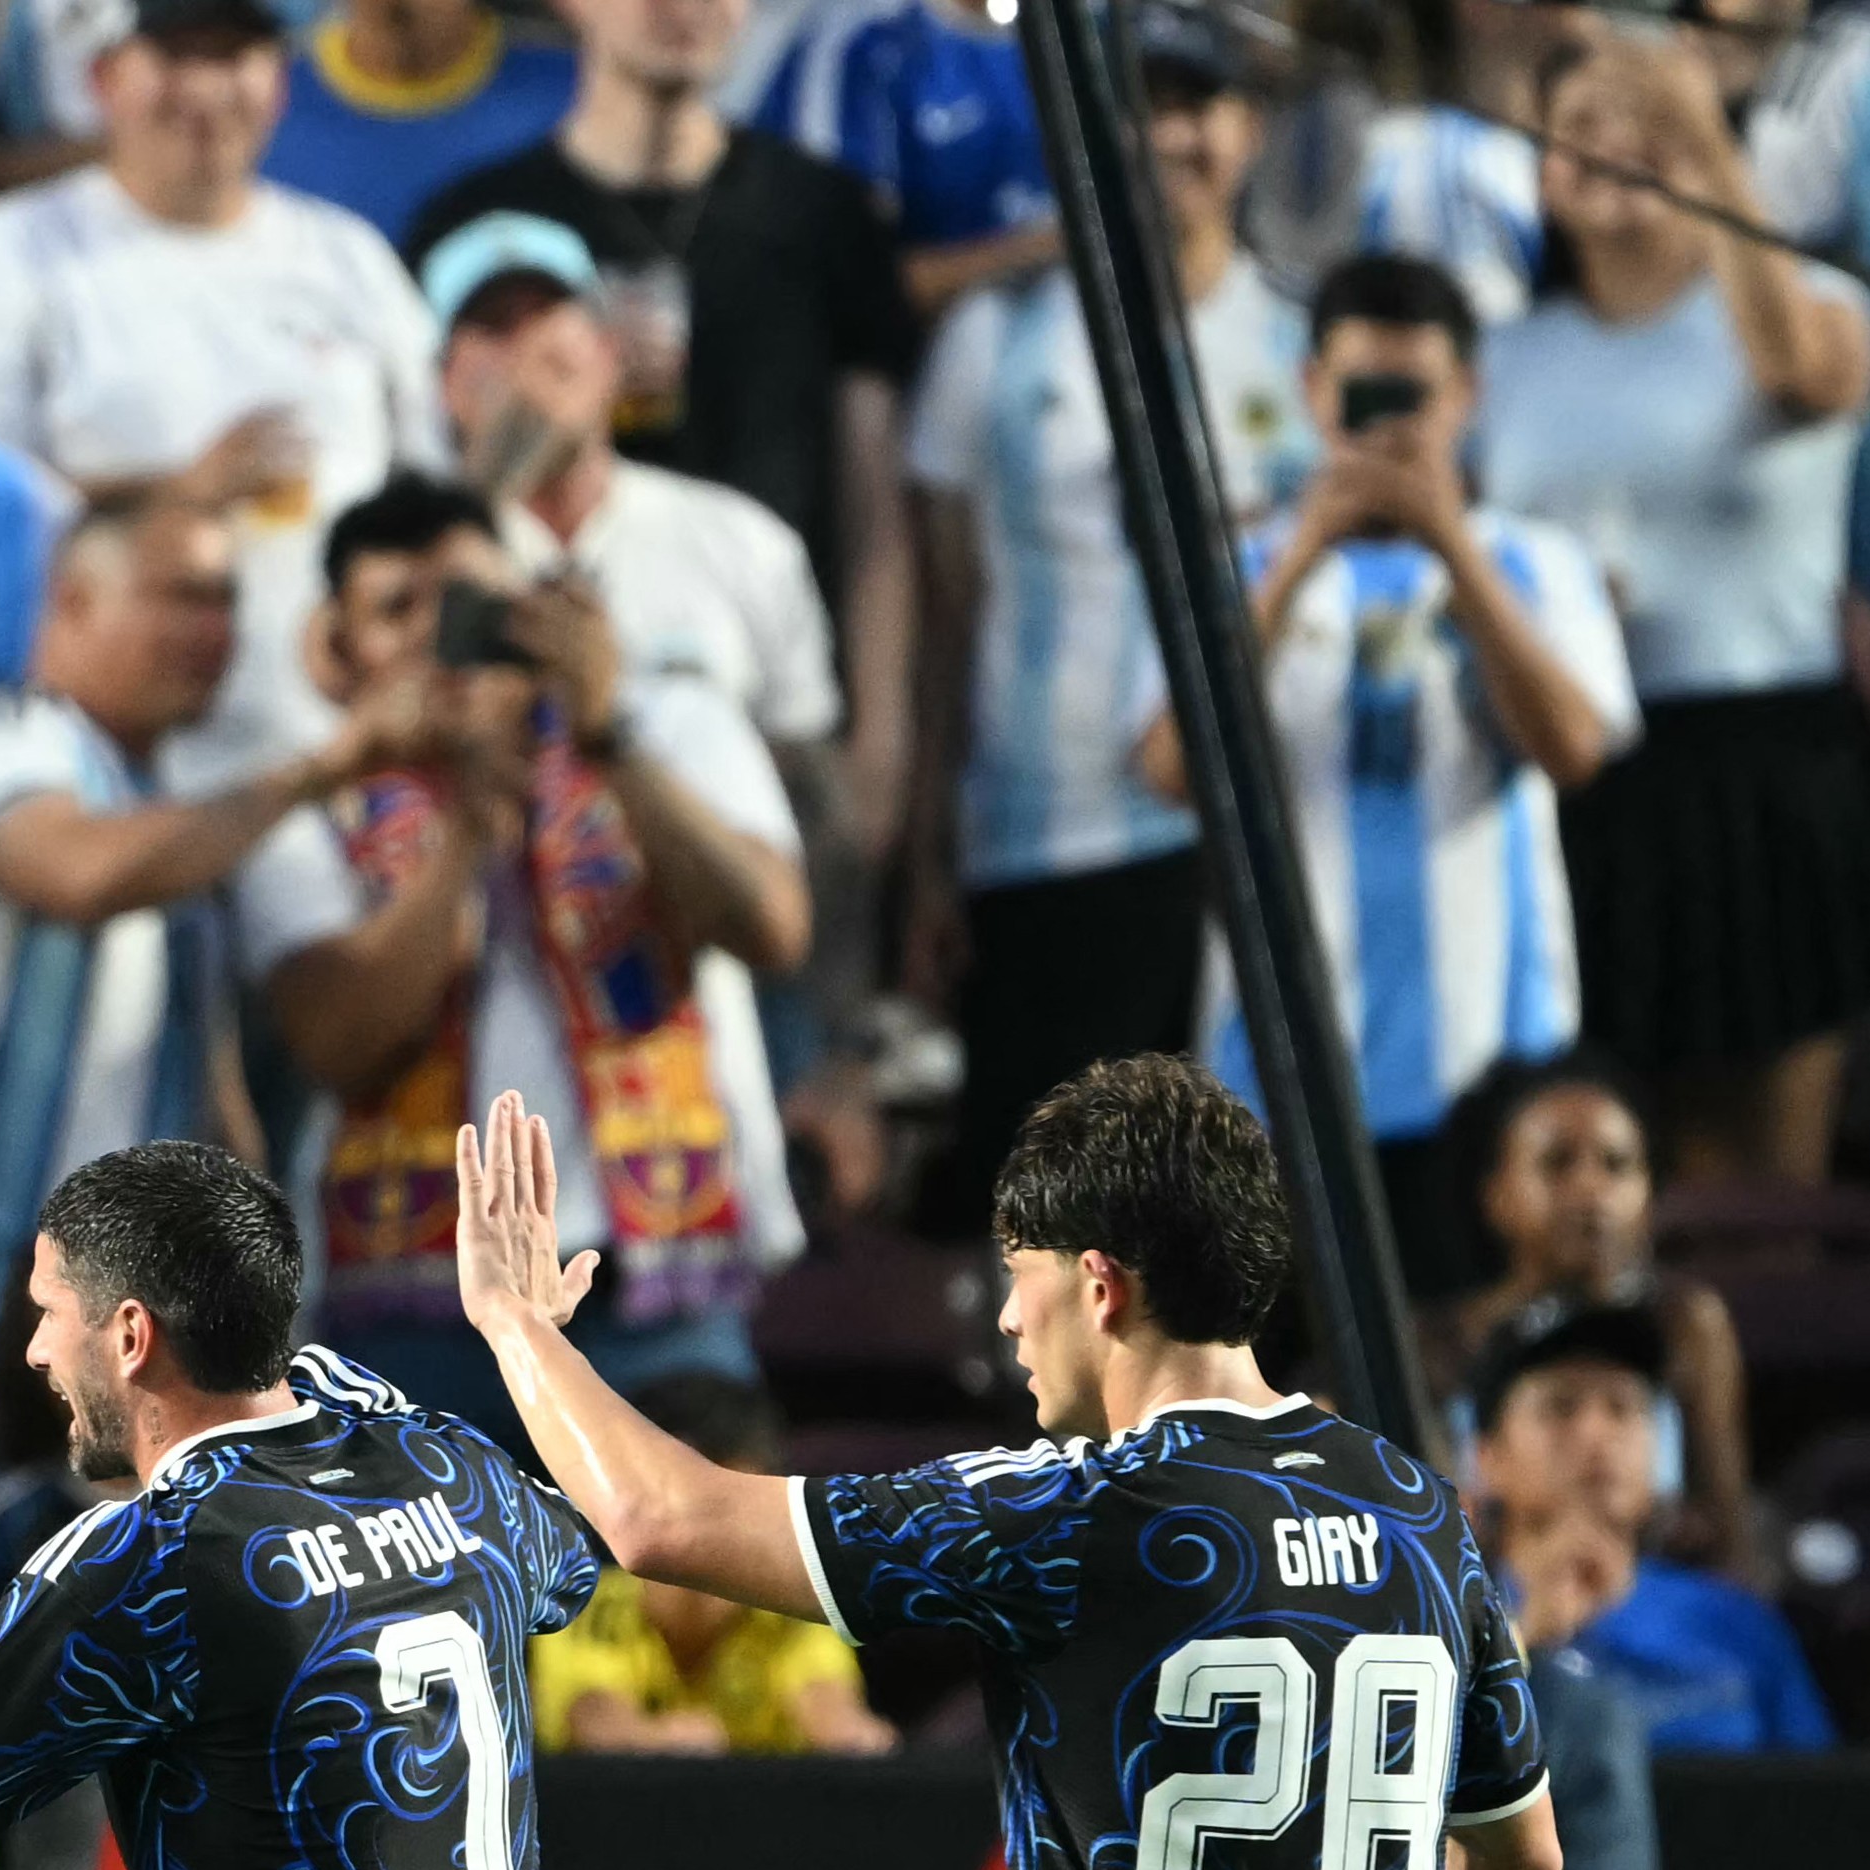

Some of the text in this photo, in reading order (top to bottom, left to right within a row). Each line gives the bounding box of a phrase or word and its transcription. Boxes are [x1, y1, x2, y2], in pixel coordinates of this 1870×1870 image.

[287, 1491, 482, 1596] DE PAUL
[1273, 1513, 1379, 1586] GIAY
